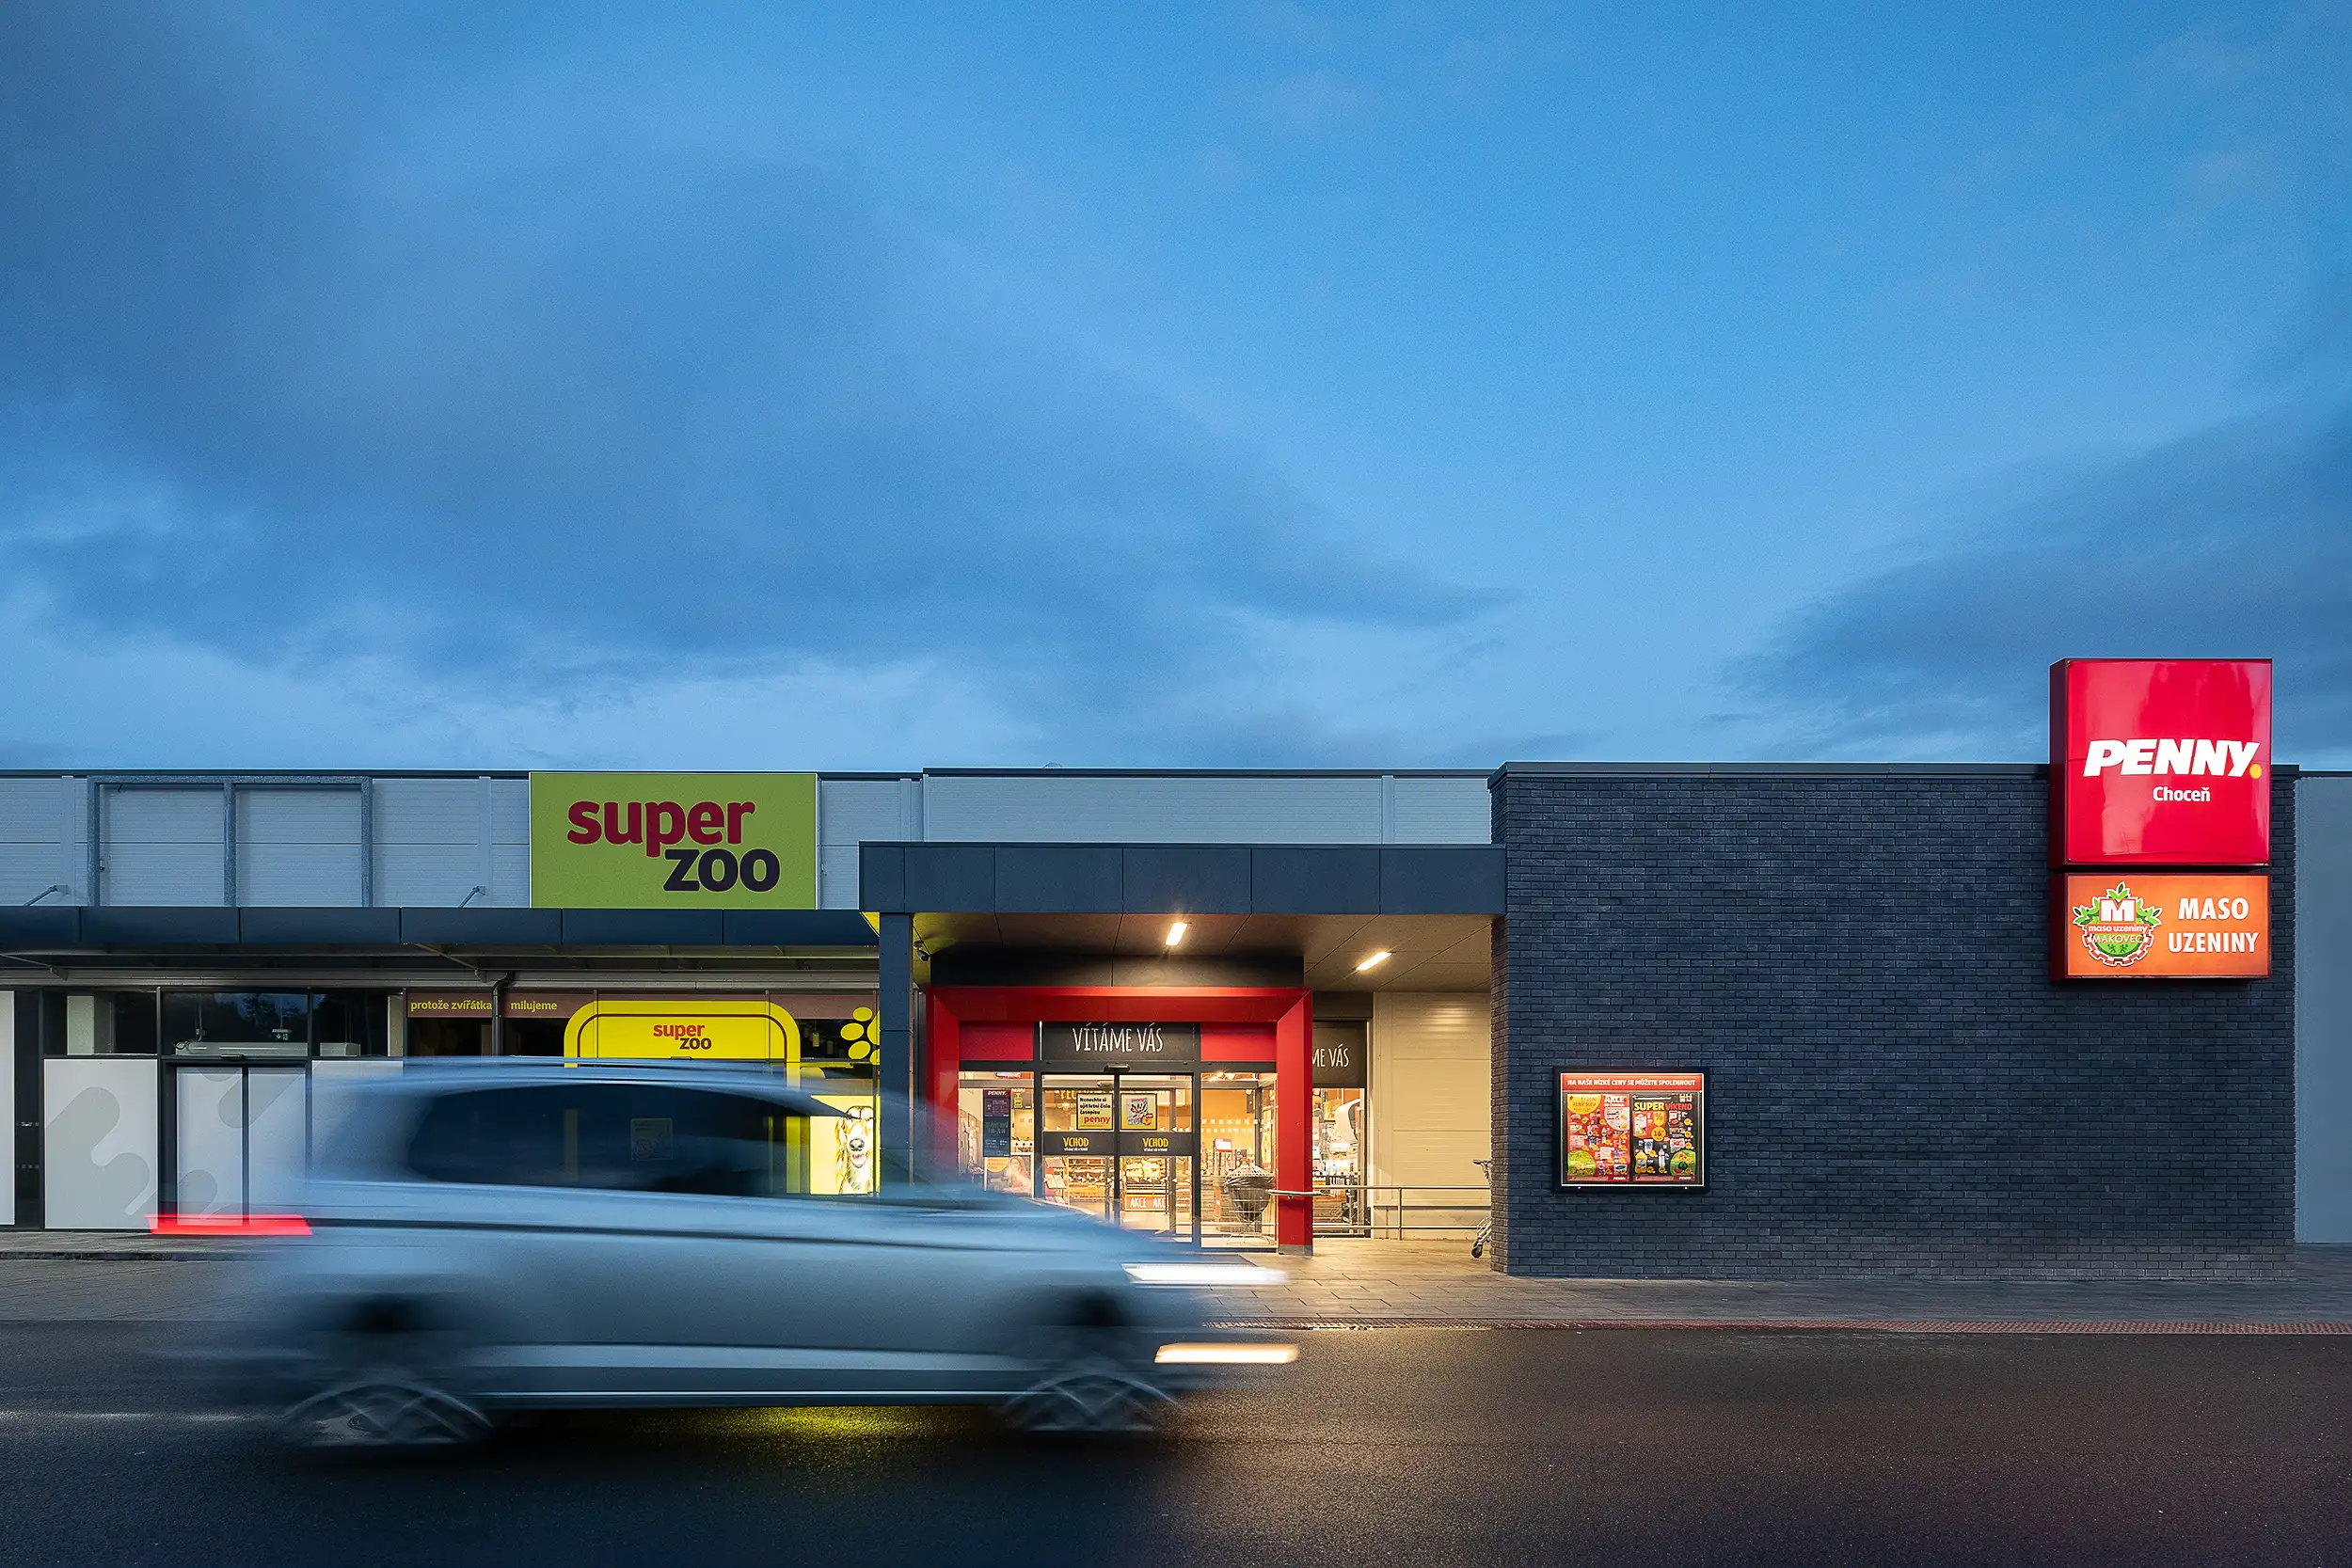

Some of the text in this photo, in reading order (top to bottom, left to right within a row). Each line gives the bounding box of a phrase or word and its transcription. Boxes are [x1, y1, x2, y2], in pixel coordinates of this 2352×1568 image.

[2153, 786, 2211, 802] Choceň
[566, 800, 756, 858] super
[662, 847, 781, 893] zoo
[2100, 899, 2136, 922] M
[2178, 897, 2249, 920] MASO
[2113, 924, 2149, 934] uzeniny
[2091, 934, 2144, 943] MAKOVEC
[2168, 932, 2259, 953] UZENINY
[410, 999, 492, 1012] protože zvířátka
[511, 1000, 558, 1013] milujeme
[653, 1024, 706, 1040] super
[1072, 1022, 1164, 1053] VÍTÁME VÁS
[679, 1037, 712, 1051] zoo
[1327, 1043, 1349, 1068] VÁS
[1603, 1095, 1625, 1103] AKCE
[1633, 1101, 1693, 1111] SUPER VÍKEND
[1084, 1116, 1111, 1125] penny
[1062, 1136, 1089, 1148] VCHOD
[1142, 1137, 1169, 1148] VCHOD
[1129, 1196, 1147, 1209] AKCE
